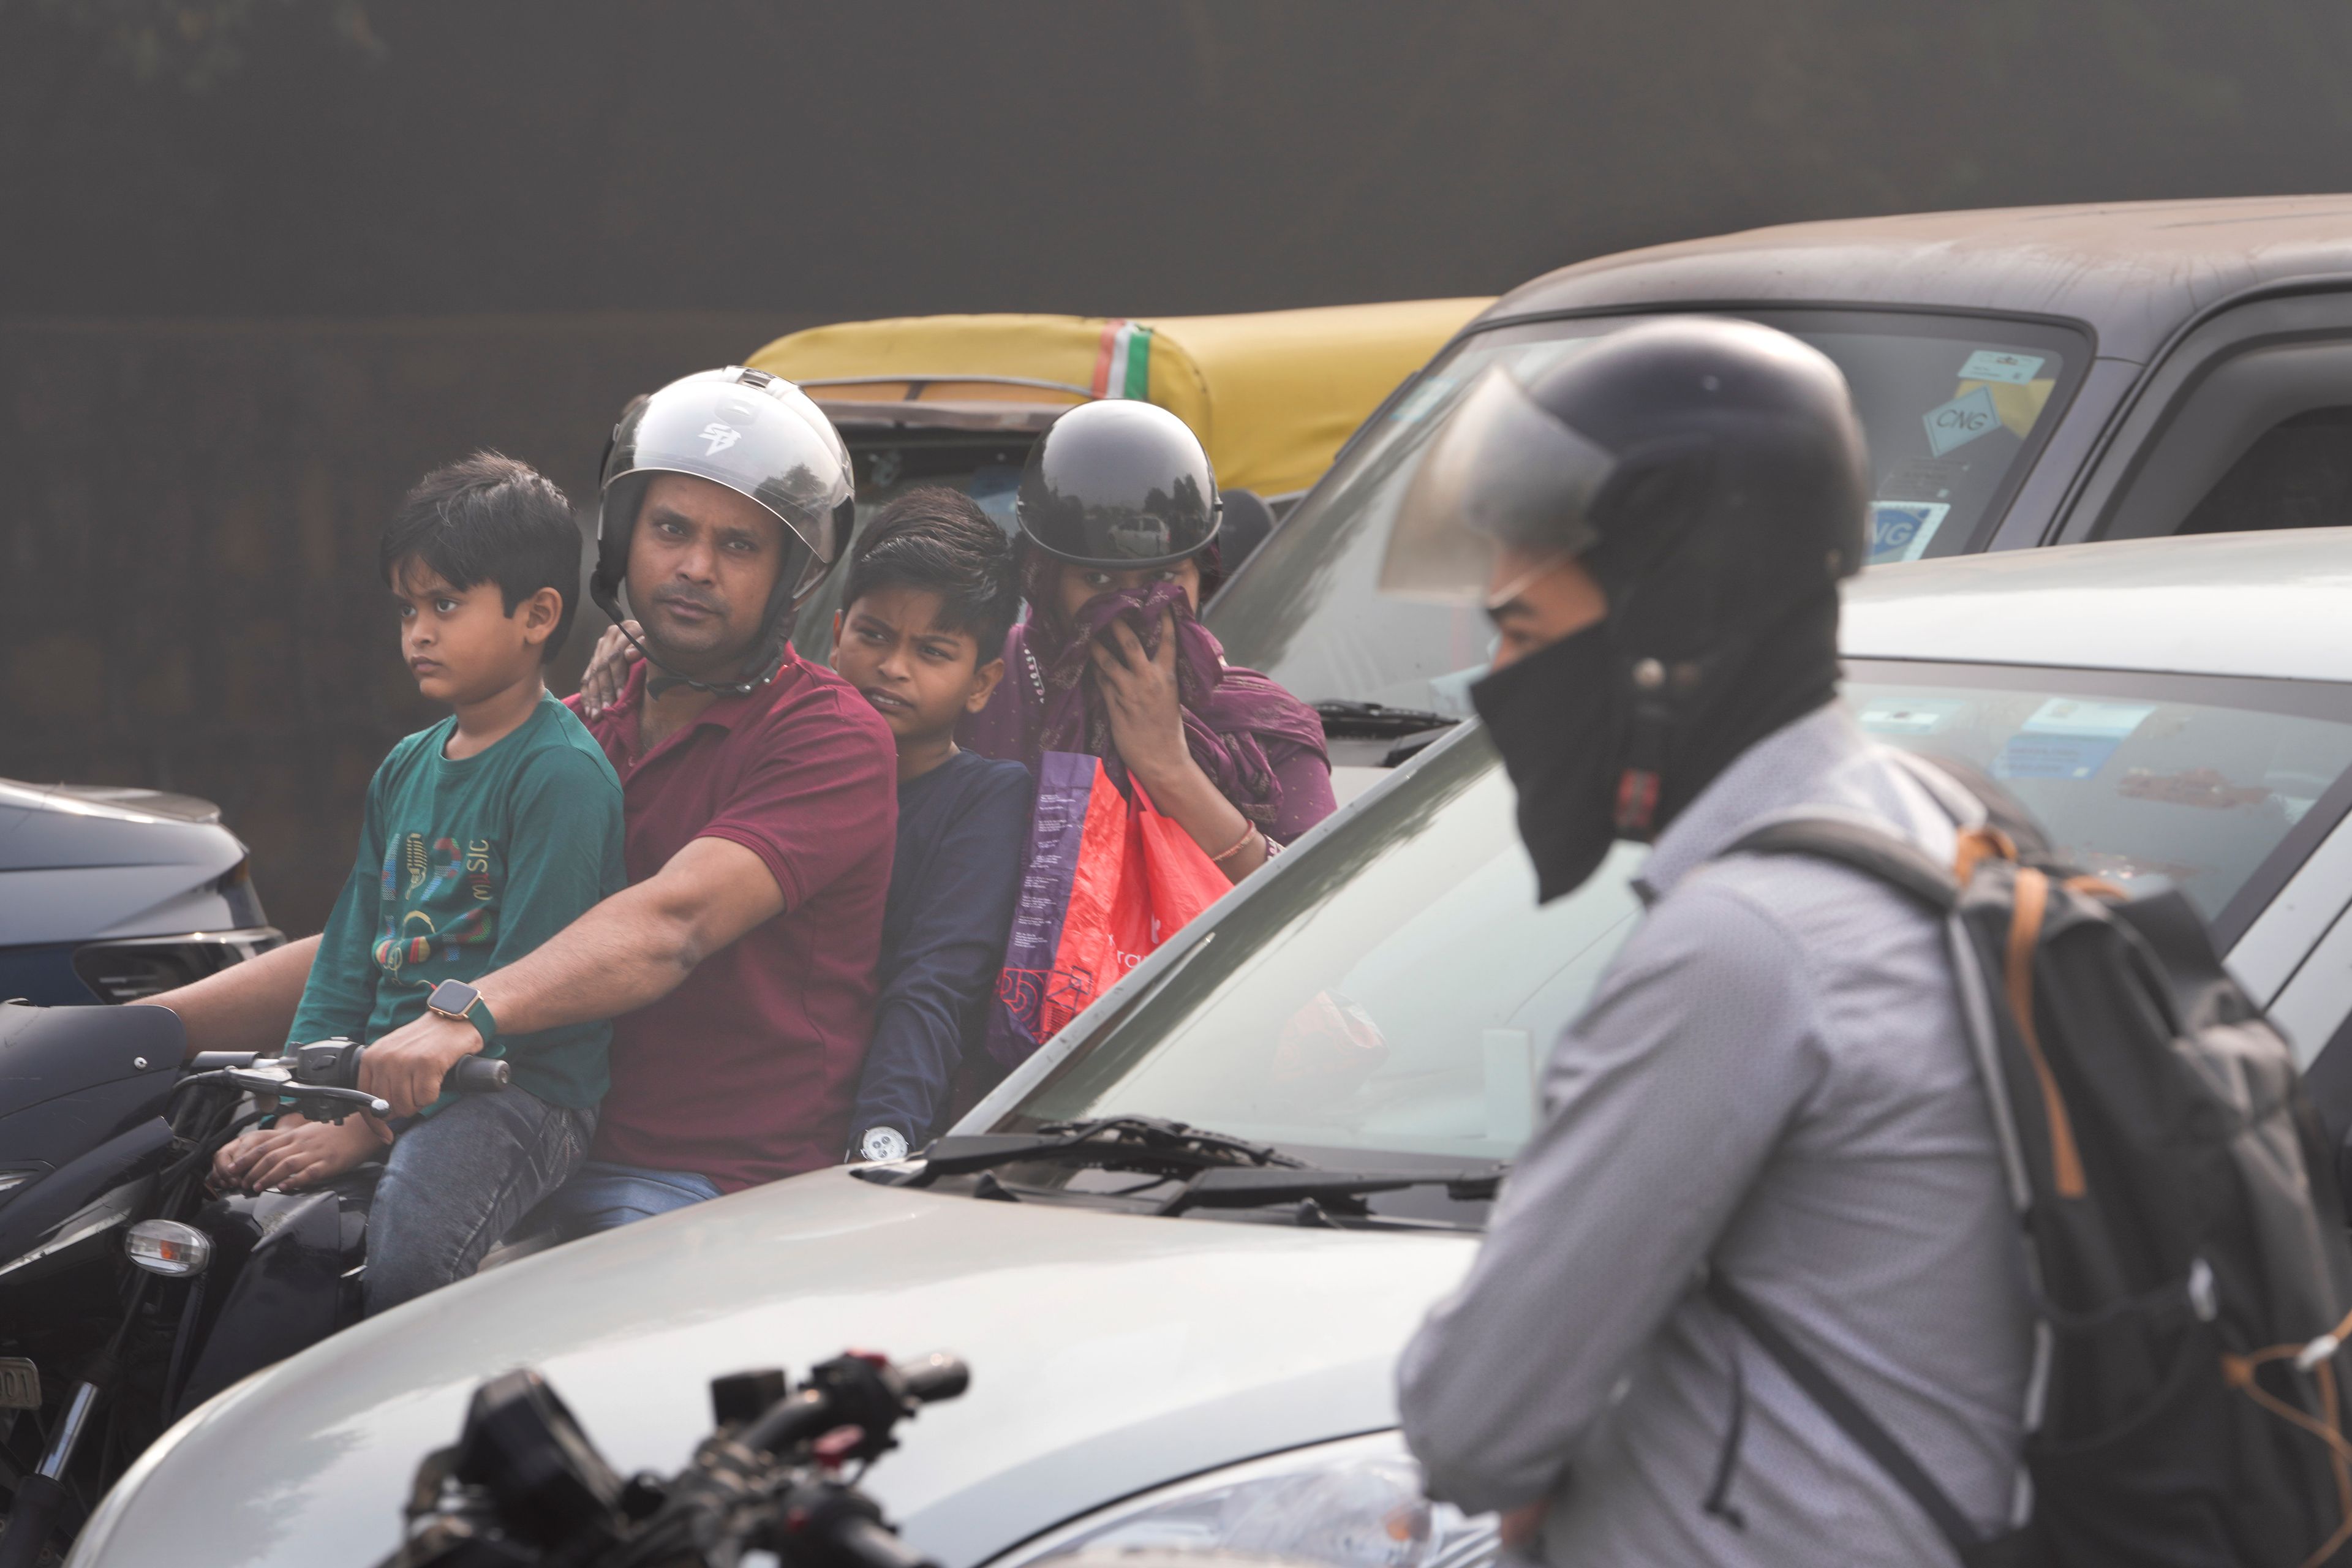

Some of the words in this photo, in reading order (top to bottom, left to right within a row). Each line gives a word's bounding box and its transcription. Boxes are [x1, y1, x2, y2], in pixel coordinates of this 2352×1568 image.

[1937, 409, 1988, 431] CNG
[1872, 522, 1913, 546] NG
[0, 1368, 30, 1402] 01
